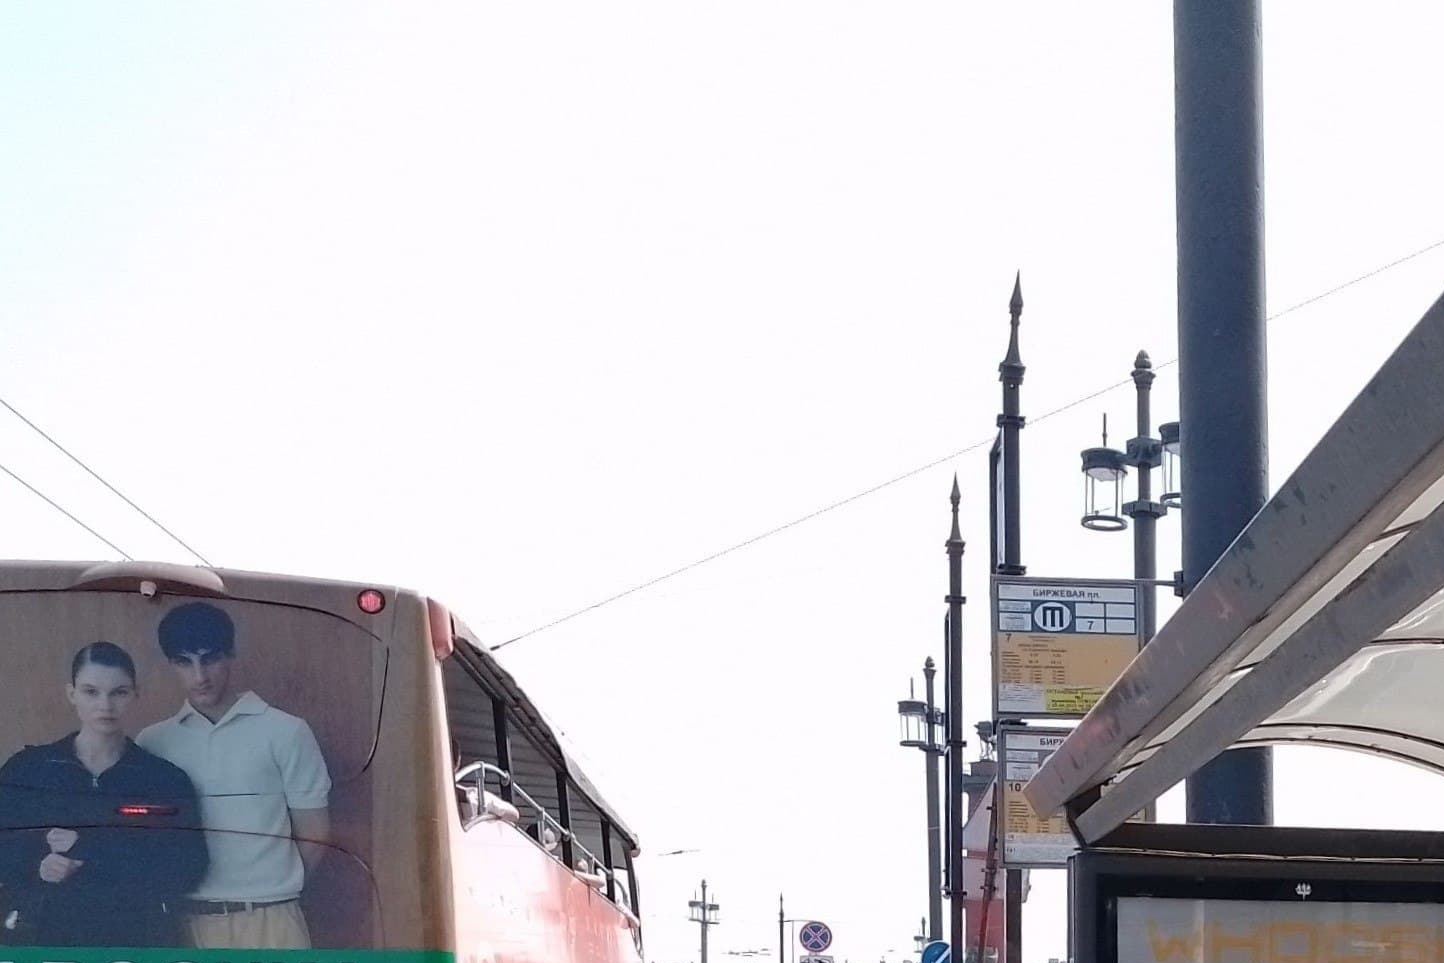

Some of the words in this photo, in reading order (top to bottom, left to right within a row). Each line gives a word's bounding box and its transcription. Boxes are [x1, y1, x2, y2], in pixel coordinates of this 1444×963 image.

[1033, 589, 1085, 598] БИРЖЕВАЯ
[1087, 621, 1094, 631] 7
[1005, 633, 1012, 642] 7
[1009, 783, 1021, 792] 10
